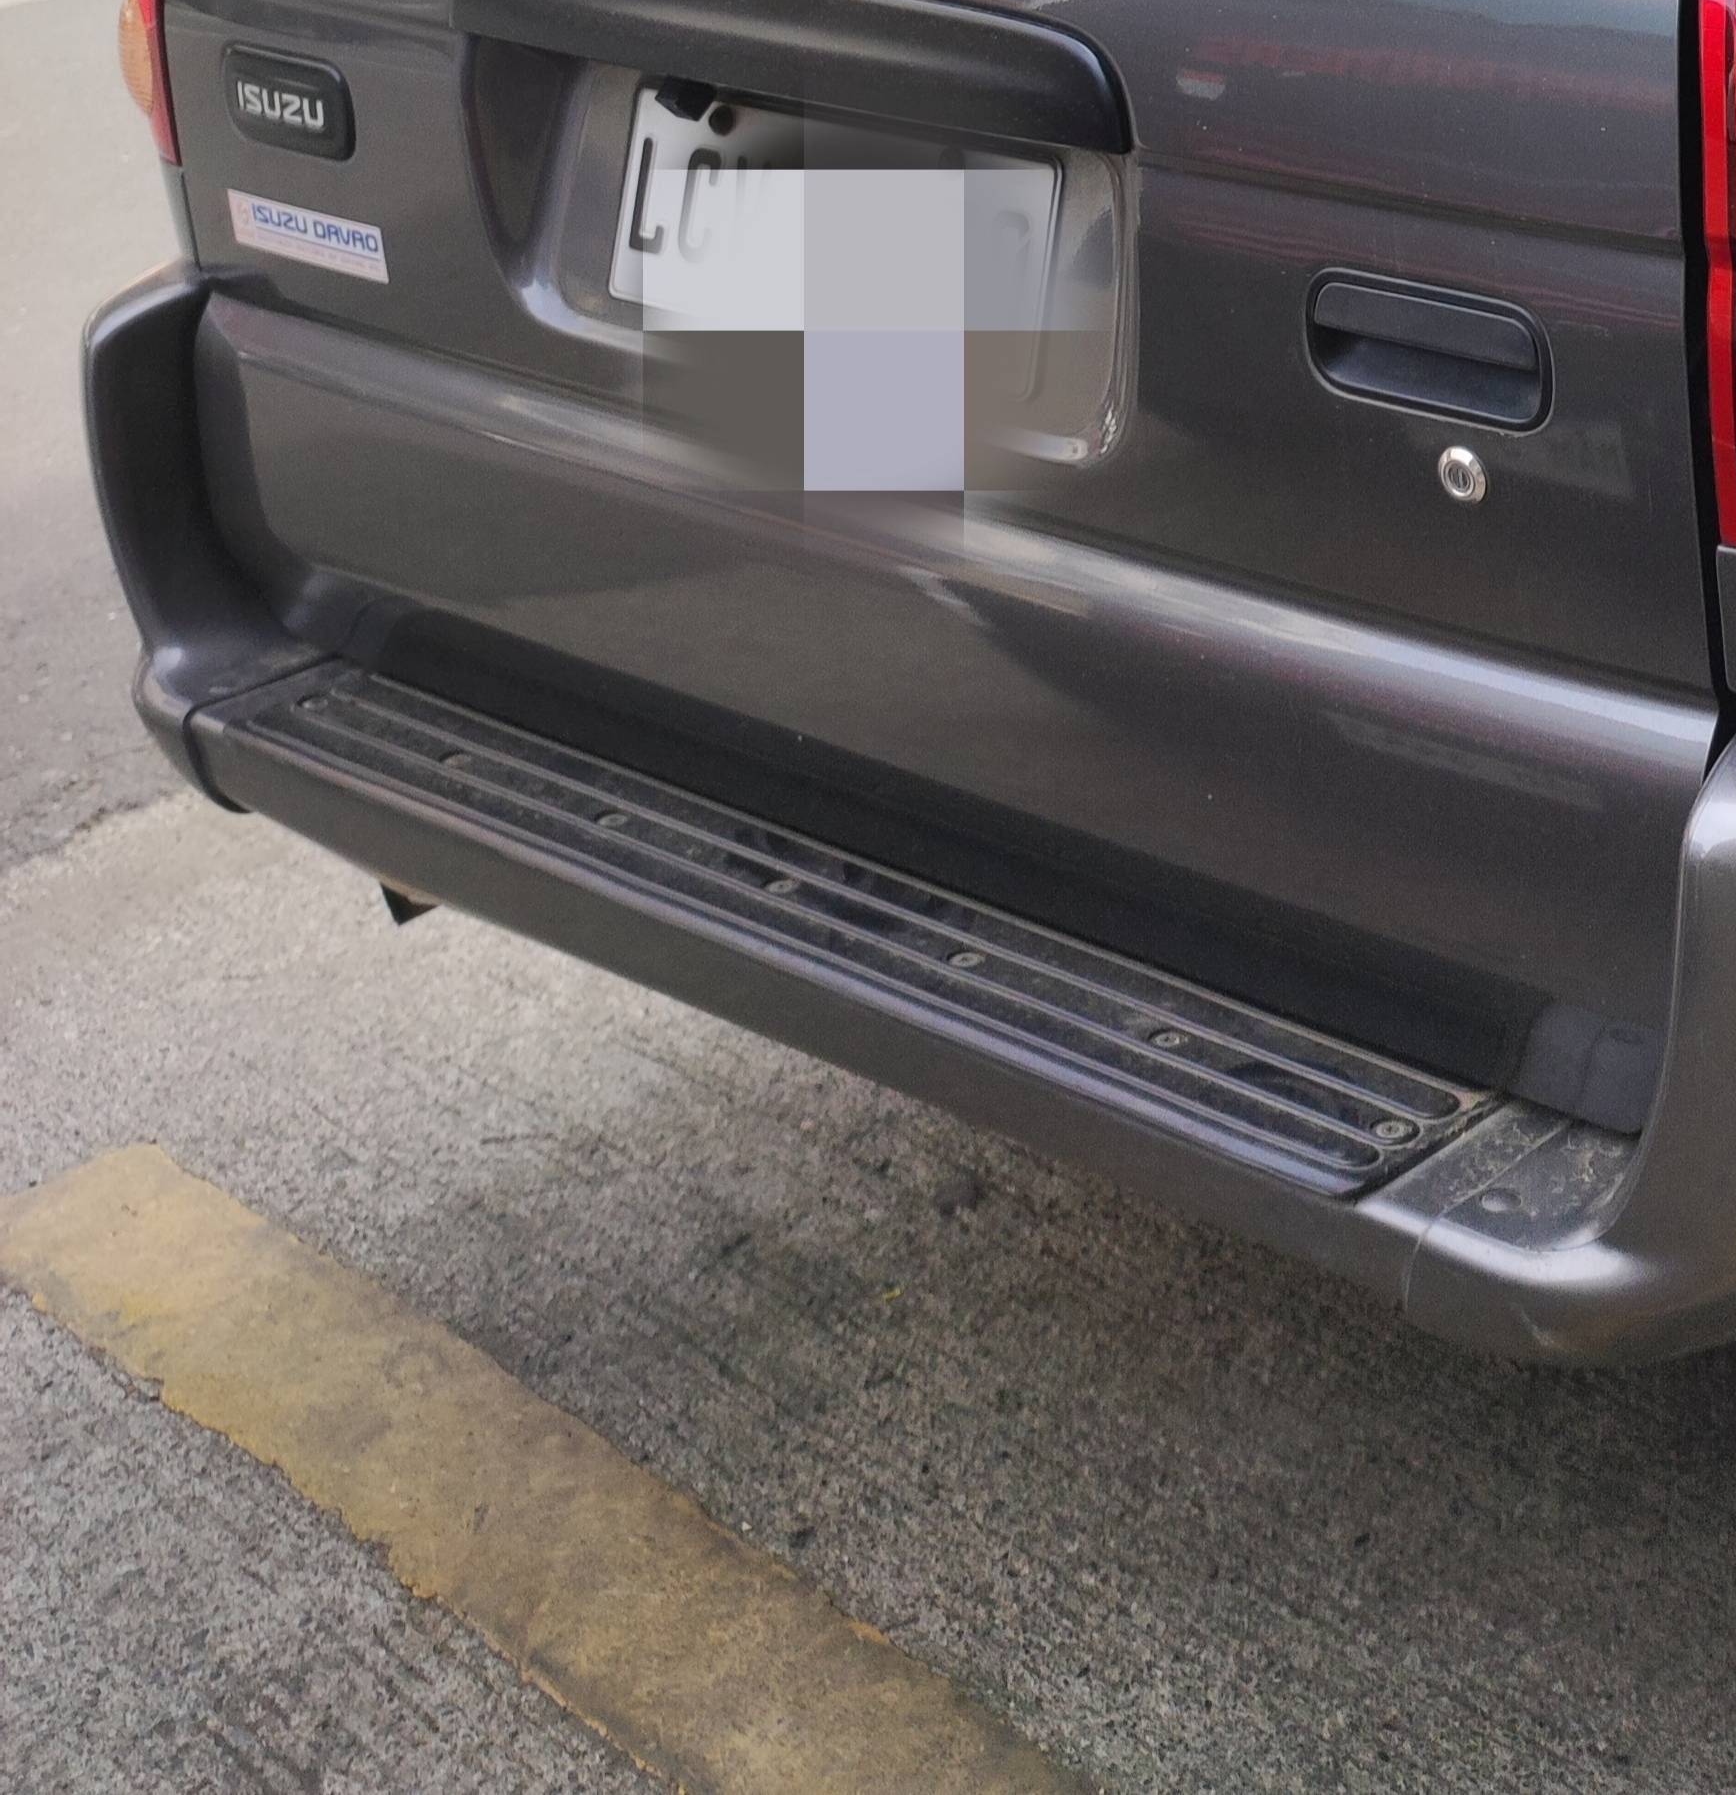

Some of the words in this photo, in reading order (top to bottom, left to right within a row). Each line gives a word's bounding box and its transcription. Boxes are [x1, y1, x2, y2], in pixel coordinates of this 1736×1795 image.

[237, 80, 324, 129] ISUZU
[252, 202, 308, 234] ISUZU
[313, 220, 379, 253] DAVAO
